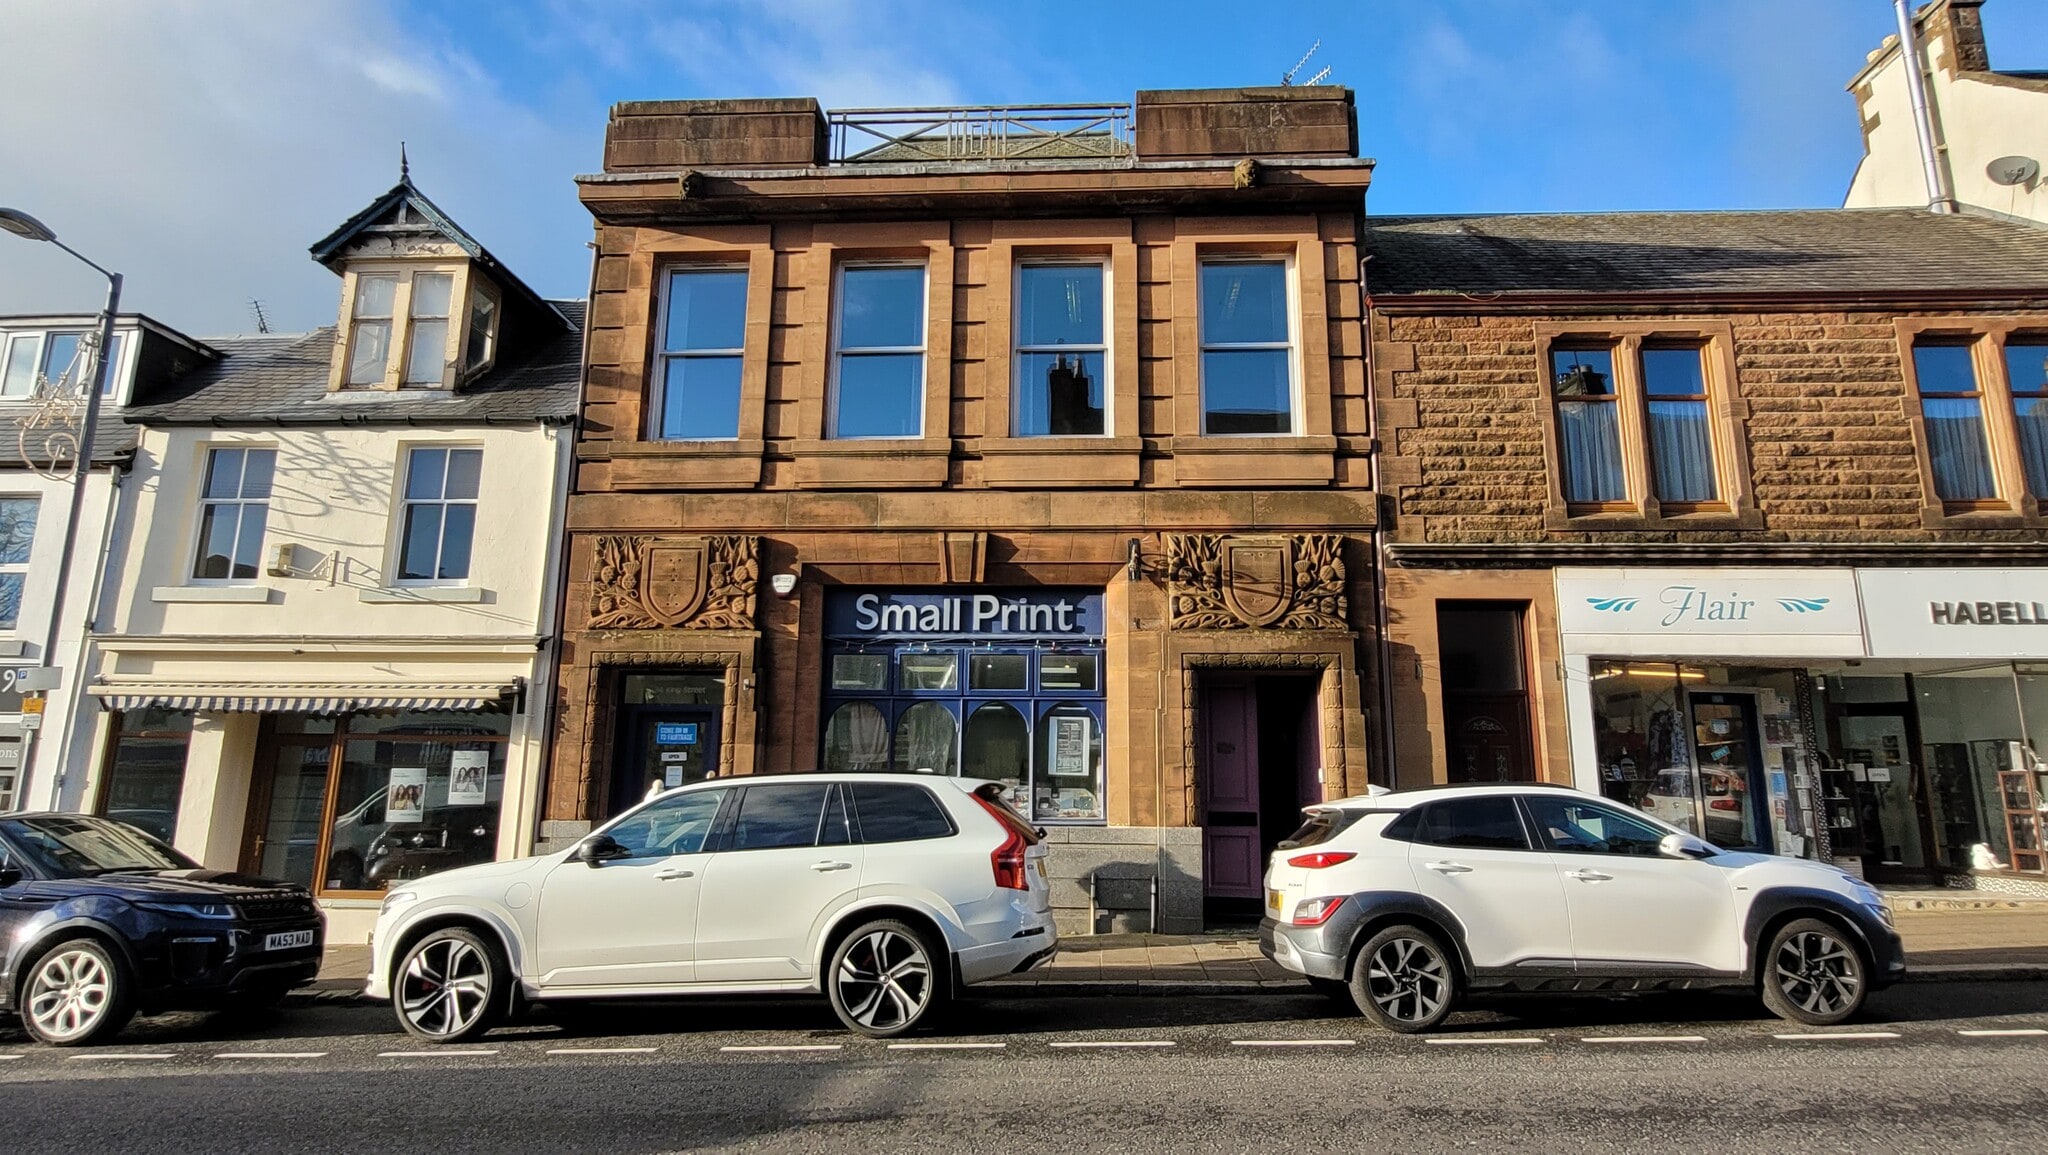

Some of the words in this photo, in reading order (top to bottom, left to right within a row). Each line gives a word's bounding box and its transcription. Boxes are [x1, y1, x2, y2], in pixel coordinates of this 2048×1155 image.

[855, 593, 960, 632] Small
[972, 594, 1073, 632] Print
[1659, 586, 1755, 627] Flair
[1930, 601, 2048, 625] HABELL
[683, 686, 706, 695] Street
[270, 934, 294, 948] MA53
